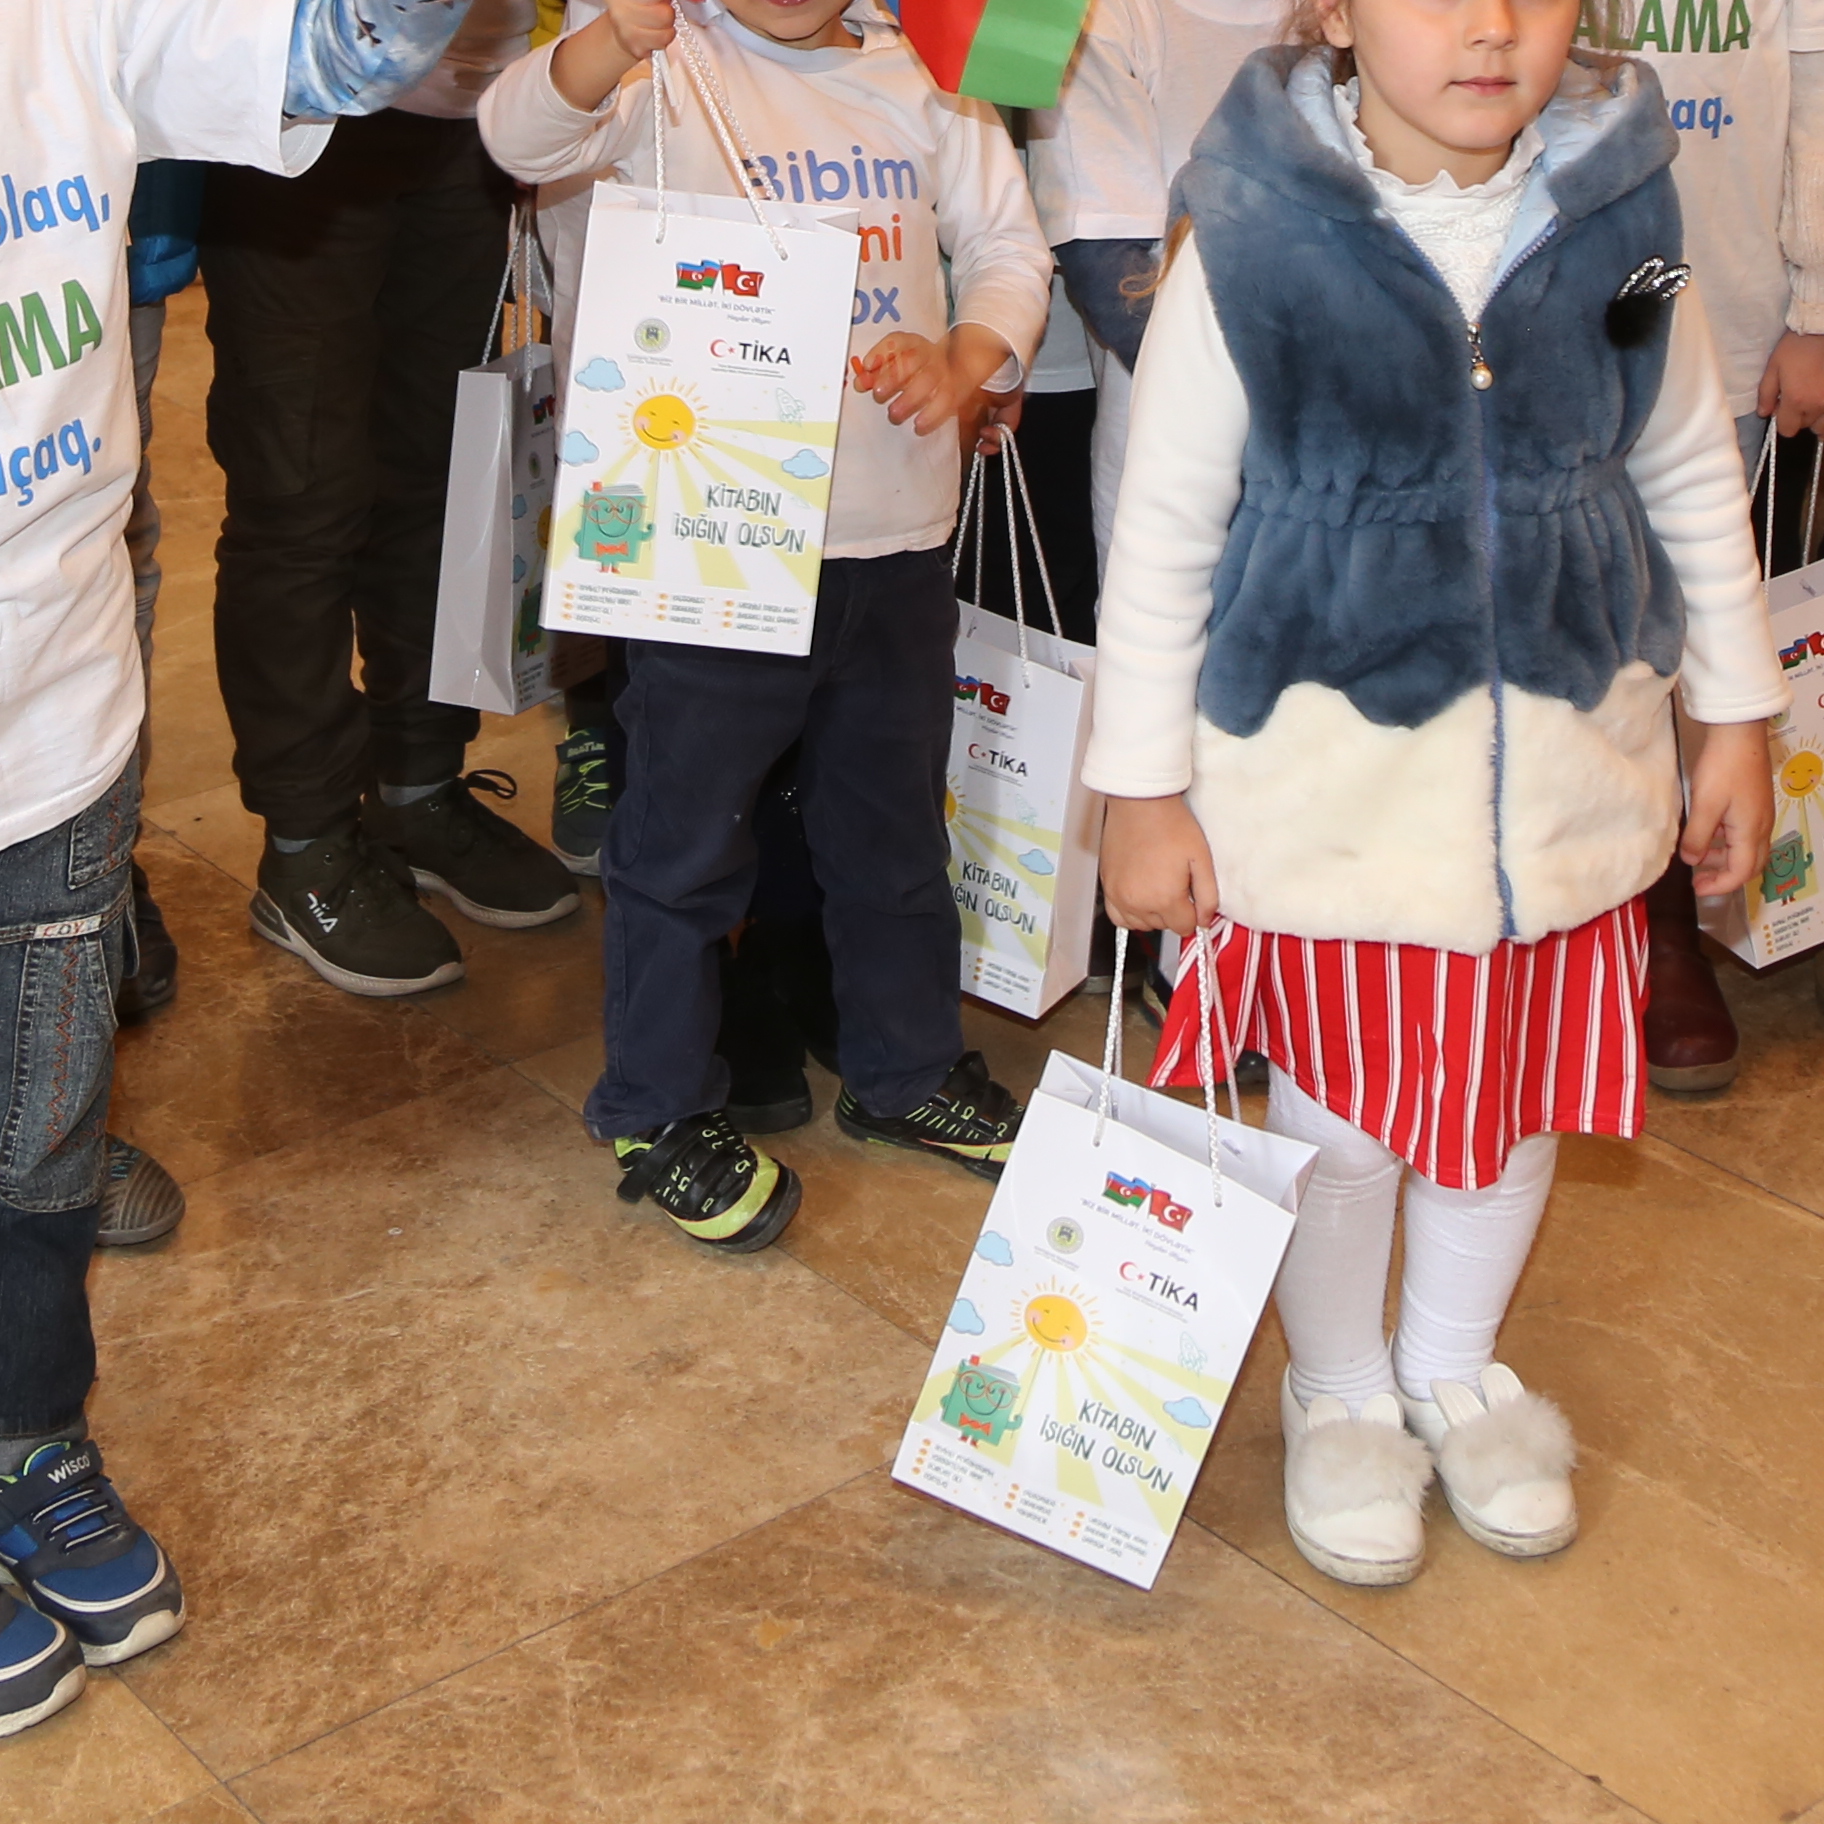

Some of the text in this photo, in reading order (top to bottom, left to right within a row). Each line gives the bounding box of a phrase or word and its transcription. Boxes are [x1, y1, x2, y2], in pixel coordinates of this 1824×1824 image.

[741, 144, 919, 204] Bibim
[738, 339, 792, 365] TİKA
[706, 480, 782, 518] KİTABIN
[673, 509, 806, 554] İŞIĞIN OLSUN
[988, 749, 1029, 777] TİKA
[962, 859, 1020, 901] KİTABIN
[984, 896, 1037, 936] OLSUN
[1149, 1271, 1199, 1312] TİKA
[1078, 1397, 1159, 1453] KİTABIN
[1039, 1413, 1176, 1496] İŞIĞIN OLSUN
